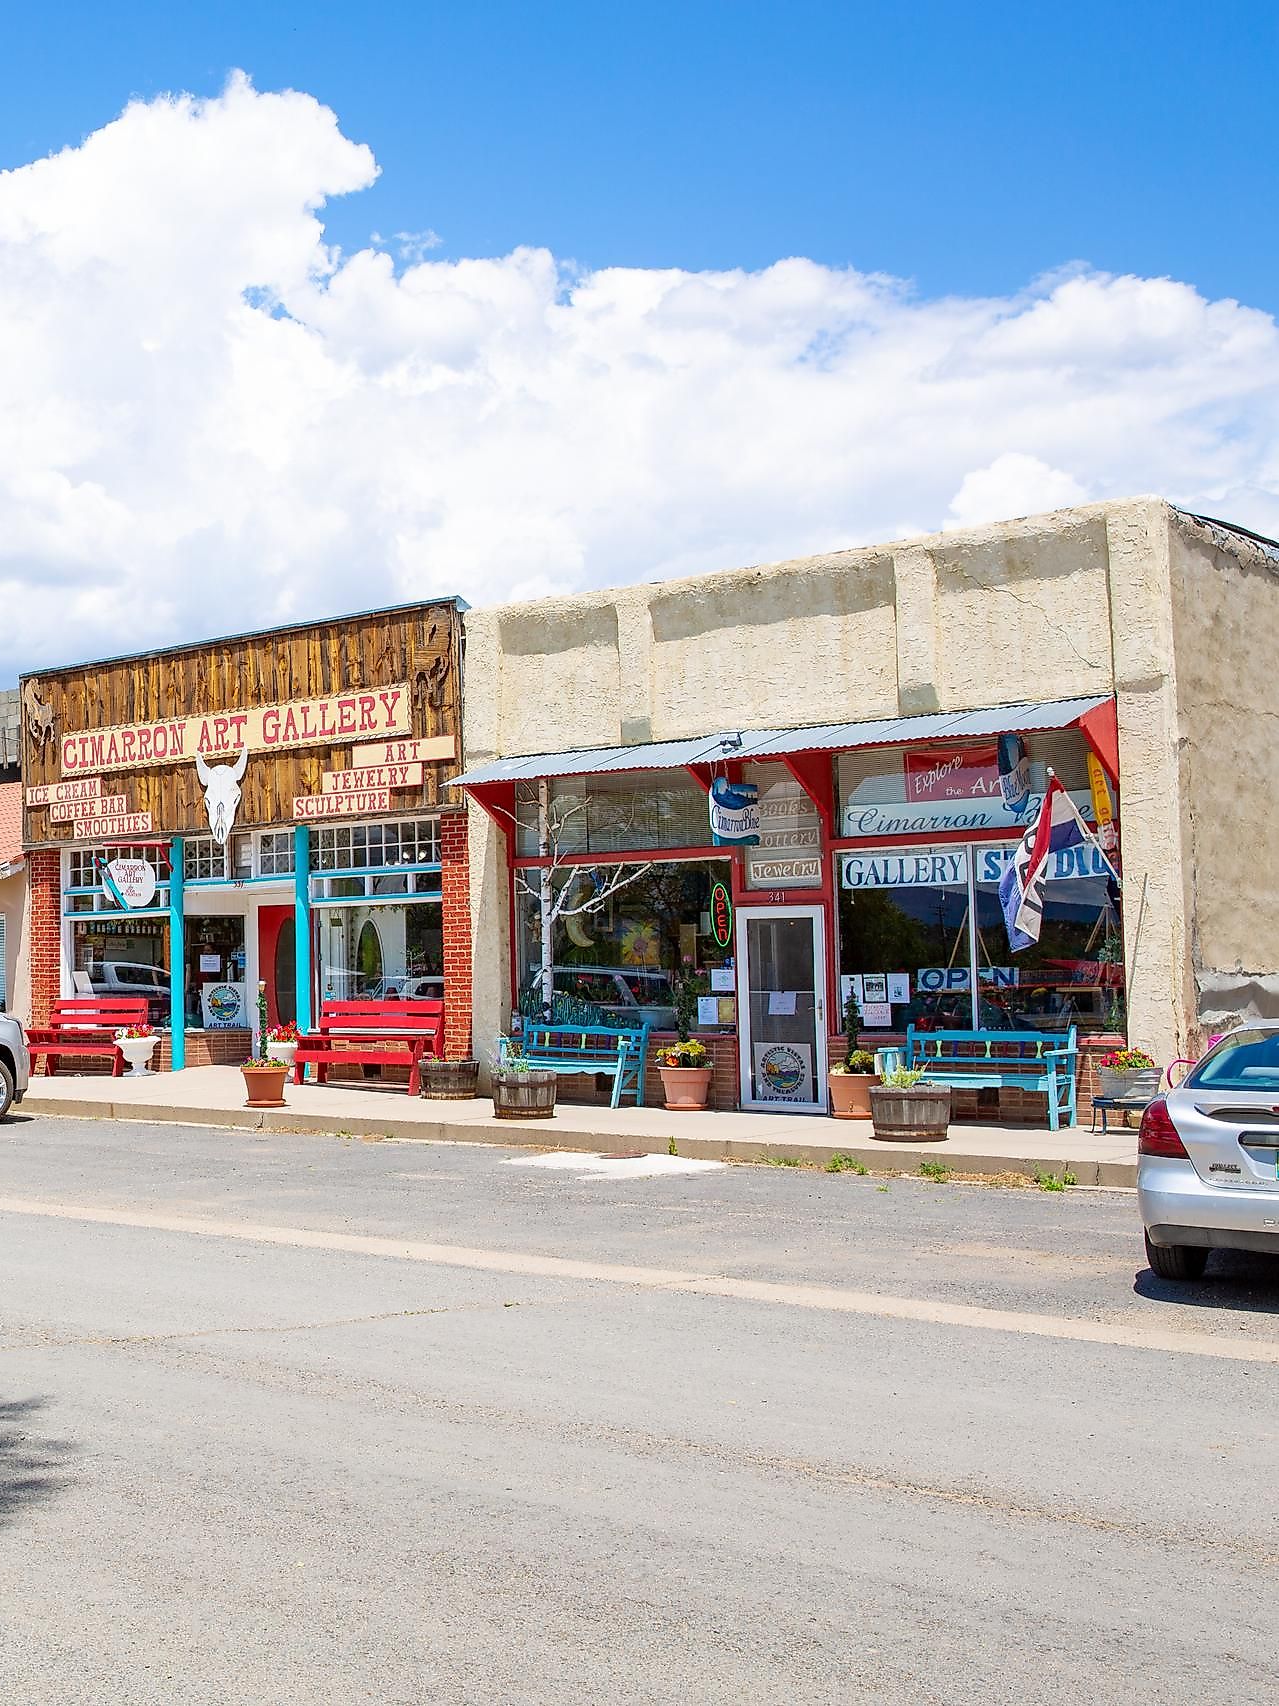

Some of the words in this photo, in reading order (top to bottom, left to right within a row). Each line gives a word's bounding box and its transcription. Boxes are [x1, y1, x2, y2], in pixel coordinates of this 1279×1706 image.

[63, 722, 186, 769] CIMARRON
[197, 715, 248, 753] ART
[262, 691, 401, 745] GALLERY
[385, 741, 421, 763] ART
[332, 766, 409, 791] JEWELRY
[914, 755, 963, 794] Explore
[945, 786, 962, 796] the
[970, 776, 1001, 794] Ar
[29, 786, 49, 804] ICE
[56, 780, 98, 800] CREAM
[295, 791, 388, 817] SCULPTURE
[51, 800, 96, 821] COFFEE
[101, 797, 125, 815] BAR
[847, 808, 993, 834] Cimarron
[76, 814, 150, 838] SMOOTHIES
[759, 831, 816, 848] ottery
[118, 876, 144, 884] GALLERY
[125, 869, 136, 877] ART
[754, 861, 817, 879] Jewelry
[846, 854, 963, 887] GALLERY
[768, 891, 785, 903] 341
[715, 887, 728, 941] OPEN
